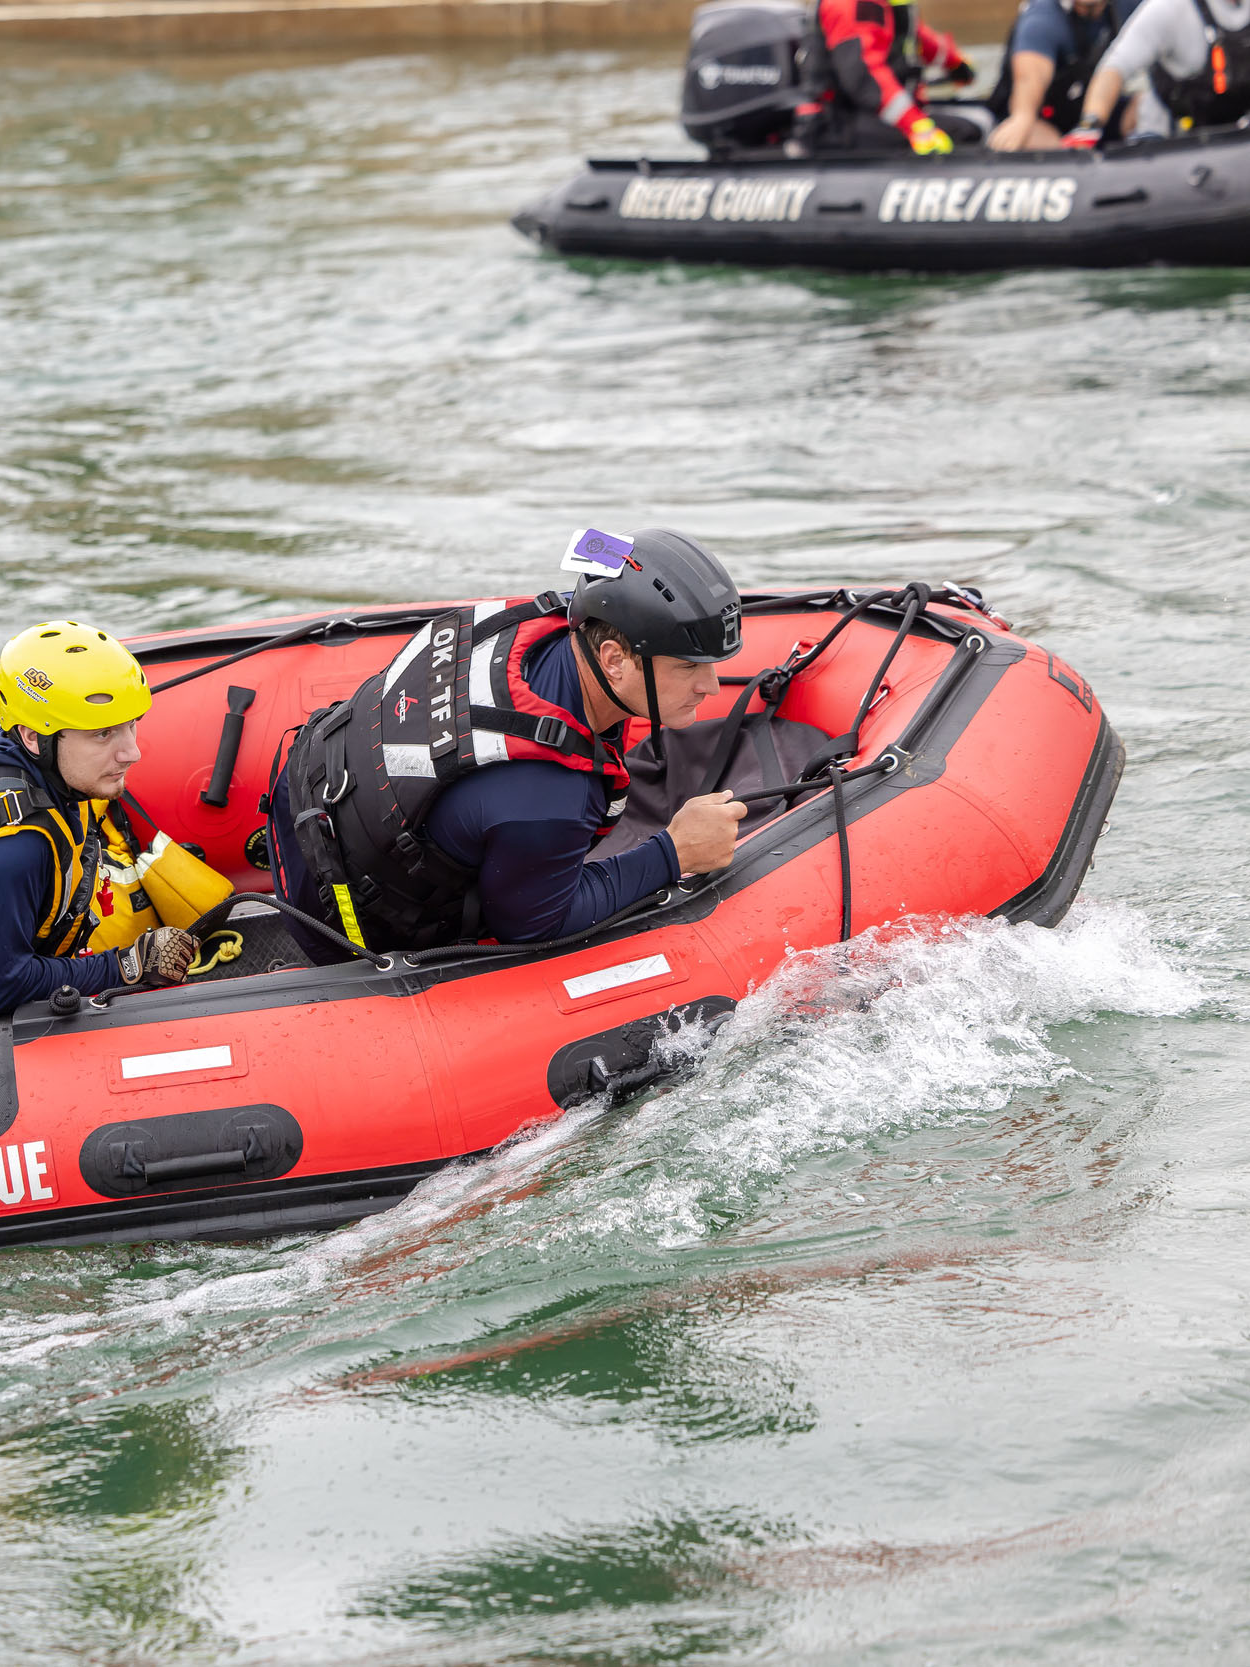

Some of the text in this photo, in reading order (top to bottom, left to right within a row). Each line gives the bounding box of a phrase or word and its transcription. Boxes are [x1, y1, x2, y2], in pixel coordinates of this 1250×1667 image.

[710, 178, 815, 221] COUNTY
[878, 177, 1077, 222] FIRE/EMS
[23, 667, 54, 692] OSU
